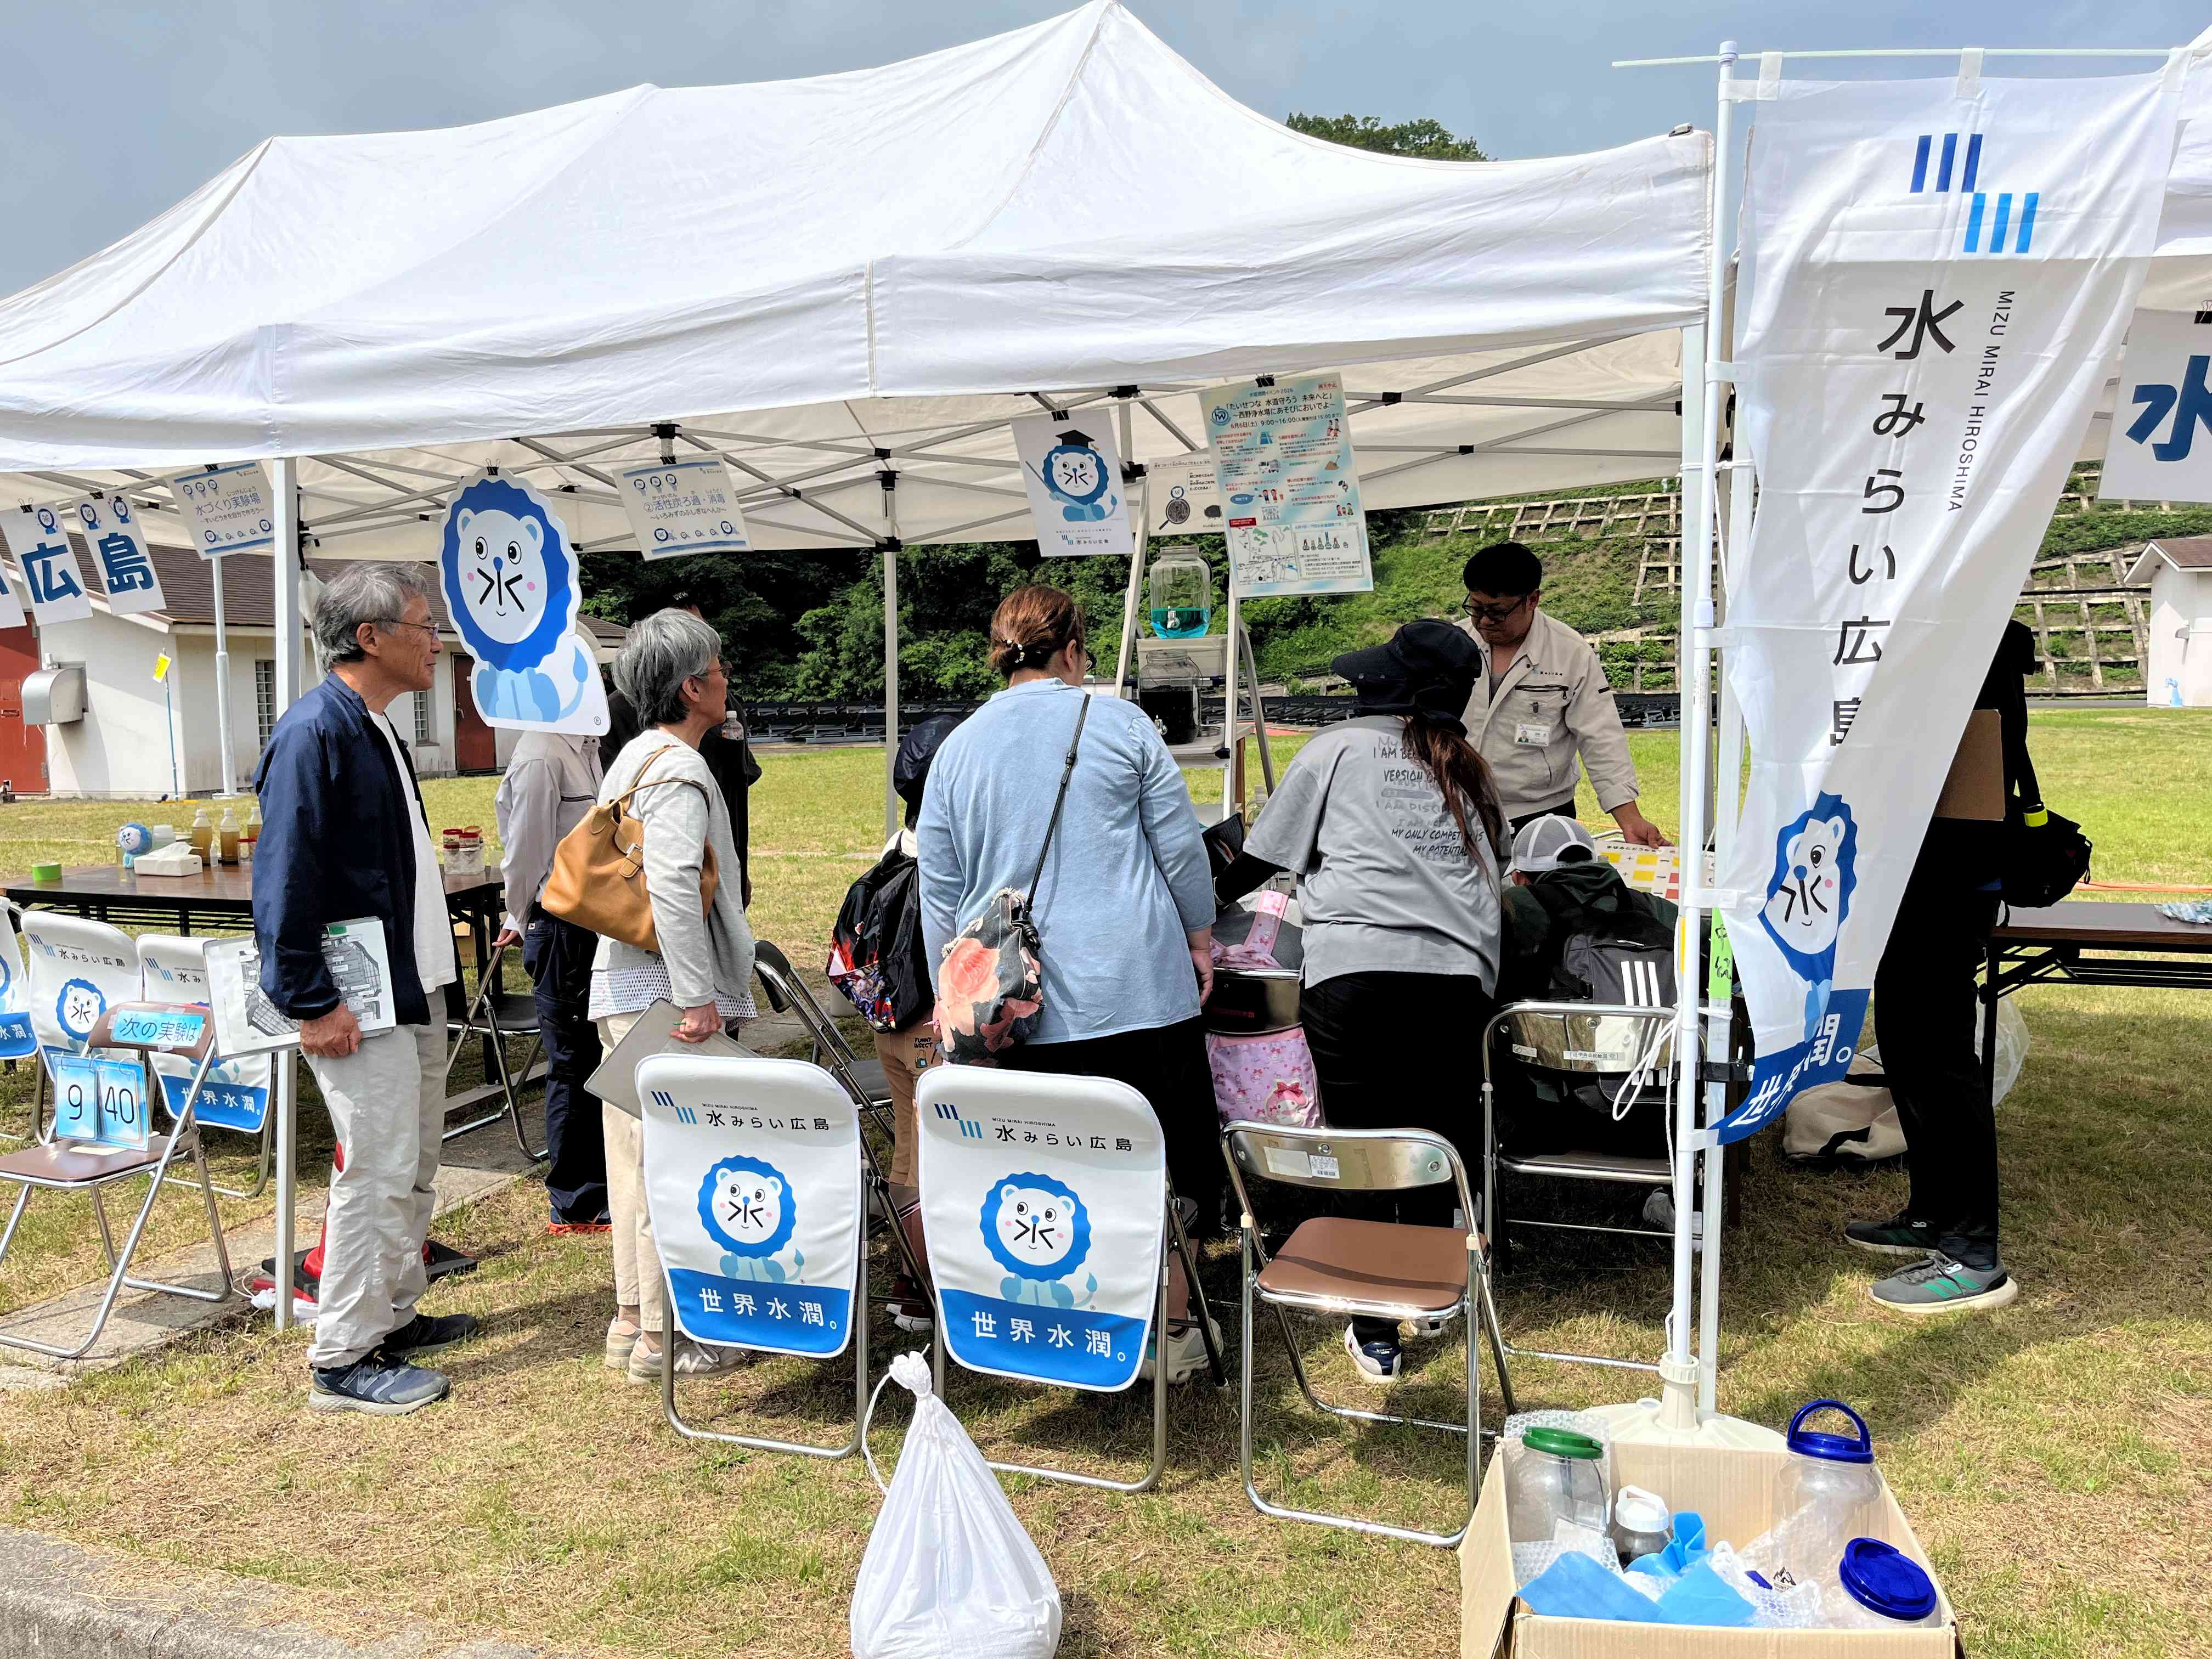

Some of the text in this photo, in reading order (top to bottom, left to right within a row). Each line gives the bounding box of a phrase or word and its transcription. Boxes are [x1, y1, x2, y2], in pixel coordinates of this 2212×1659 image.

[1265, 397, 1297, 407] 水道守ろう
[1948, 291, 2015, 512] MIZU MIRAI HIROSHIMA
[195, 492, 261, 516] 水づくり実験場
[1381, 747, 1397, 759] AM
[1384, 769, 1423, 782] VERSION
[1391, 829, 1404, 838] MY
[1405, 829, 1429, 840] ONLY
[59, 949, 125, 967] 水みらい広島
[177, 972, 207, 983] 水み
[120, 1018, 198, 1042] 次の実験は
[67, 1084, 135, 1124] 9 40
[706, 1110, 830, 1131] 水みらい広島
[995, 1125, 1132, 1152] 水みらい広島
[699, 1287, 837, 1330] 世界水潤。
[970, 1310, 1126, 1362] 世界水潤。
